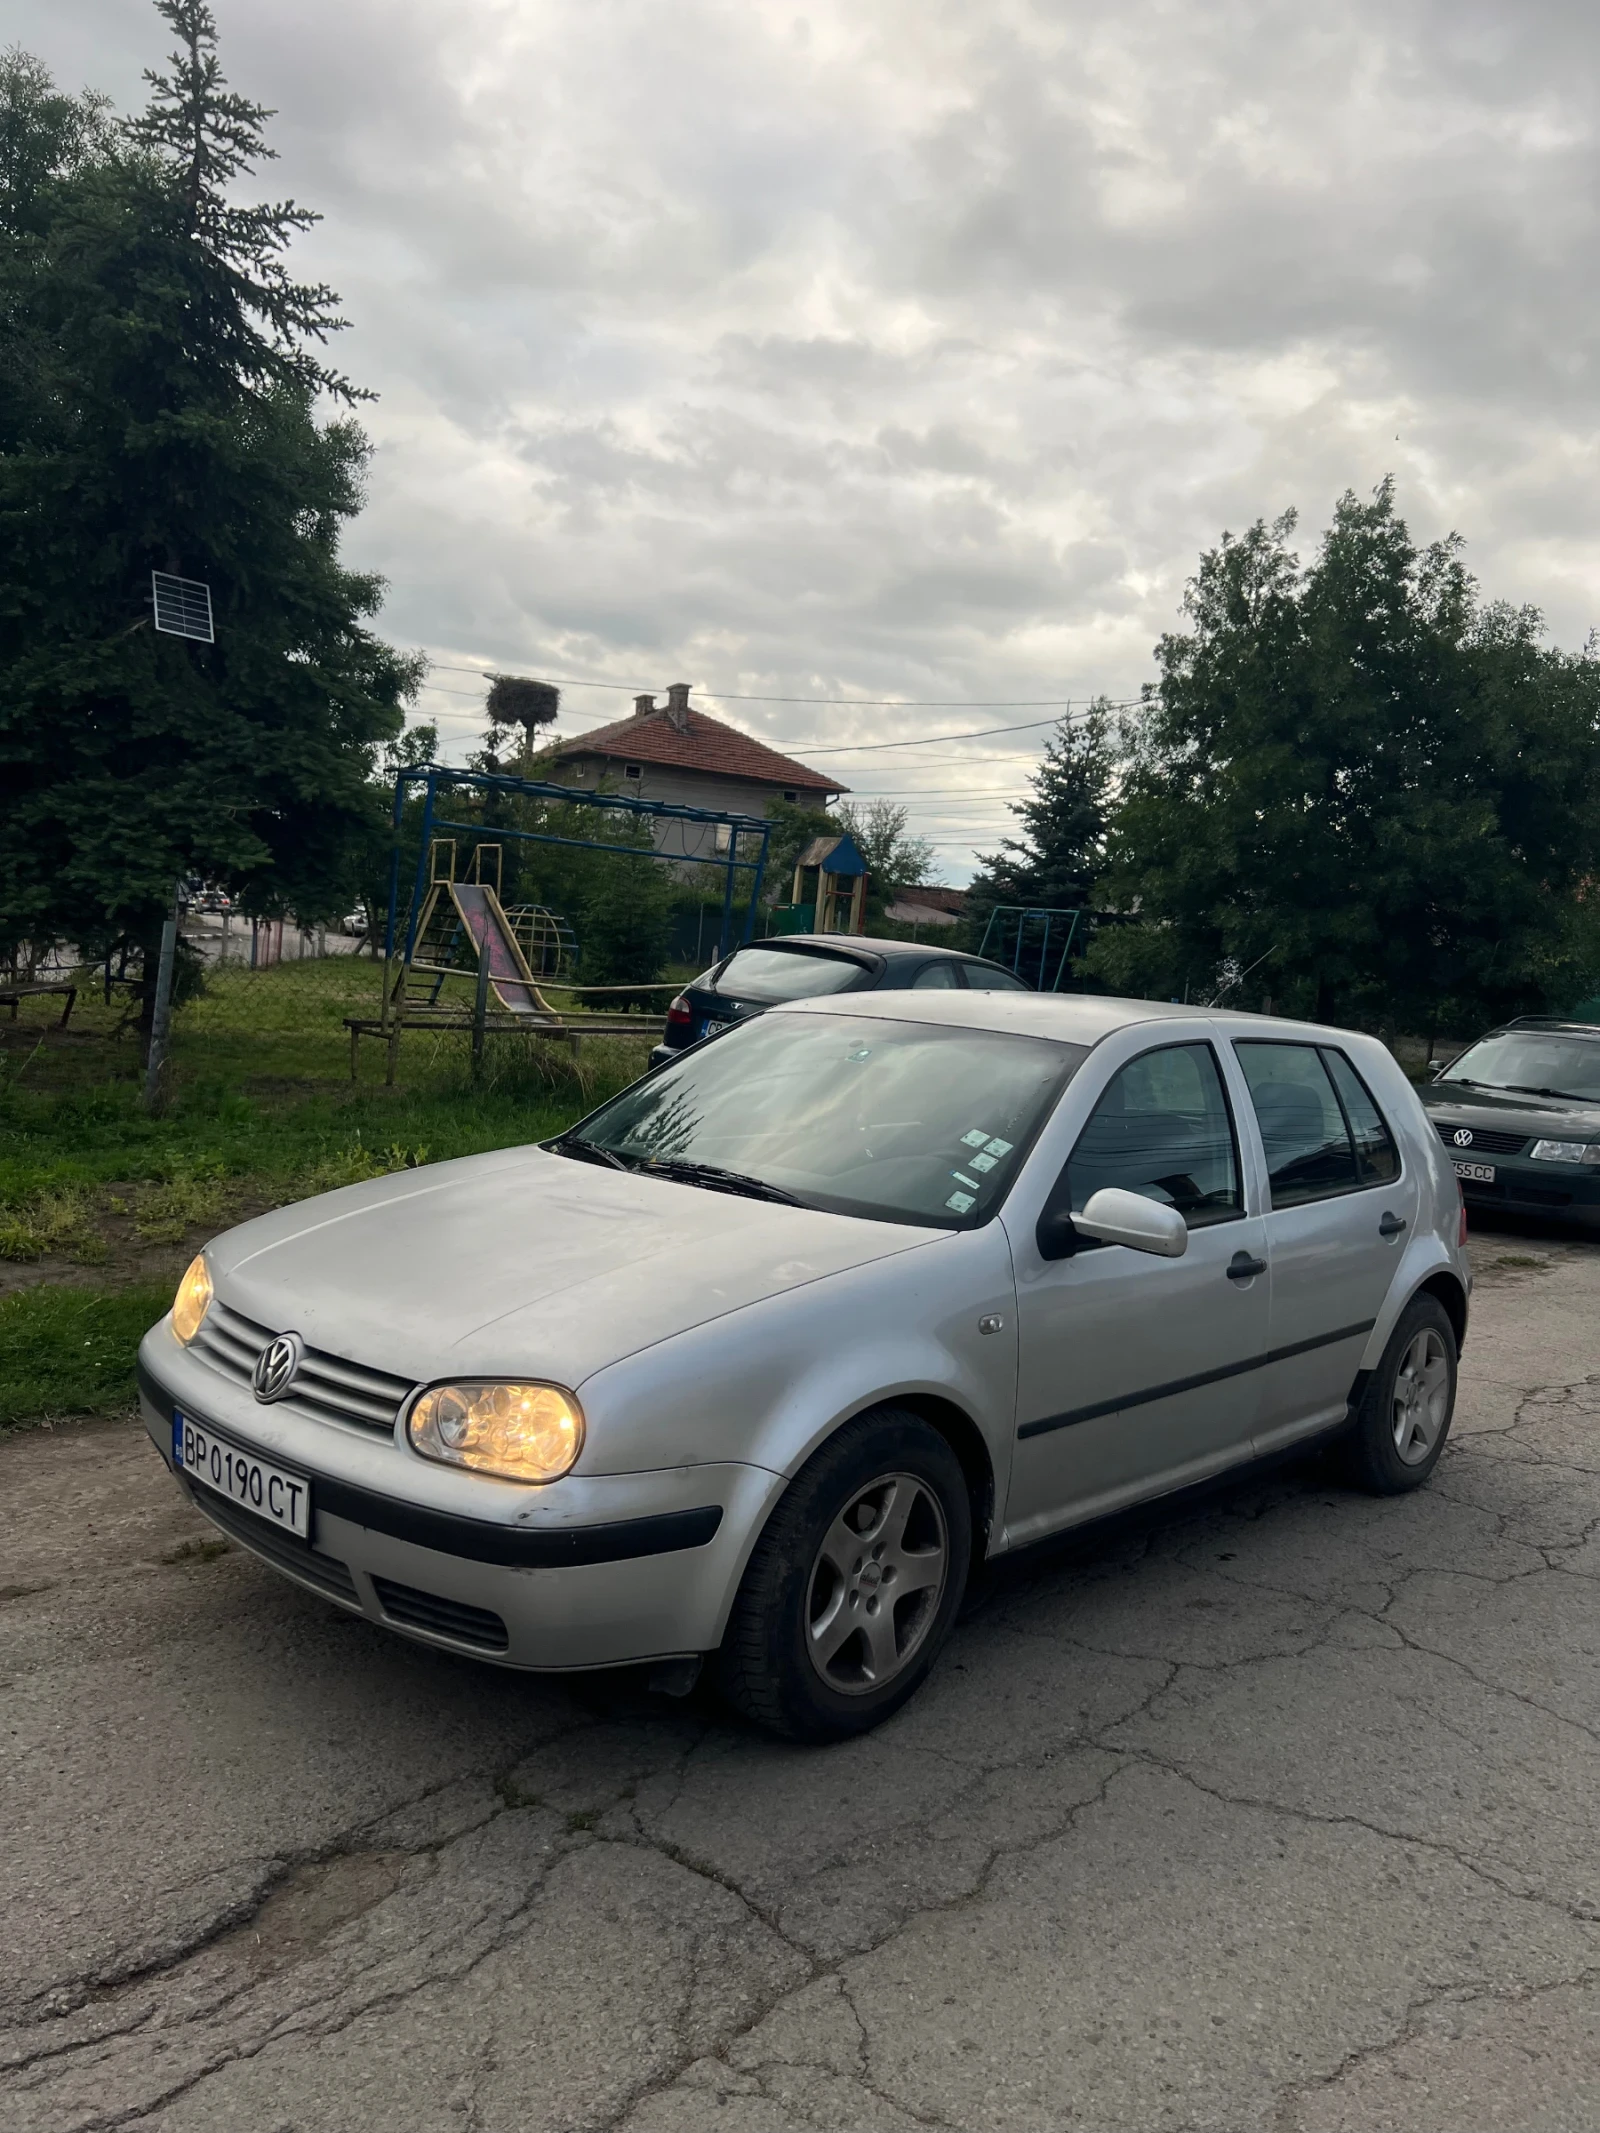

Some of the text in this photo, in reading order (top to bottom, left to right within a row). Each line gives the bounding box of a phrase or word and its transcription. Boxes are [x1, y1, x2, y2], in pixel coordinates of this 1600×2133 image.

[1454, 1129, 1473, 1147] VW
[1474, 1166, 1492, 1180] CC
[256, 1338, 294, 1397] VW
[185, 1425, 303, 1526] BP 0190 CT
